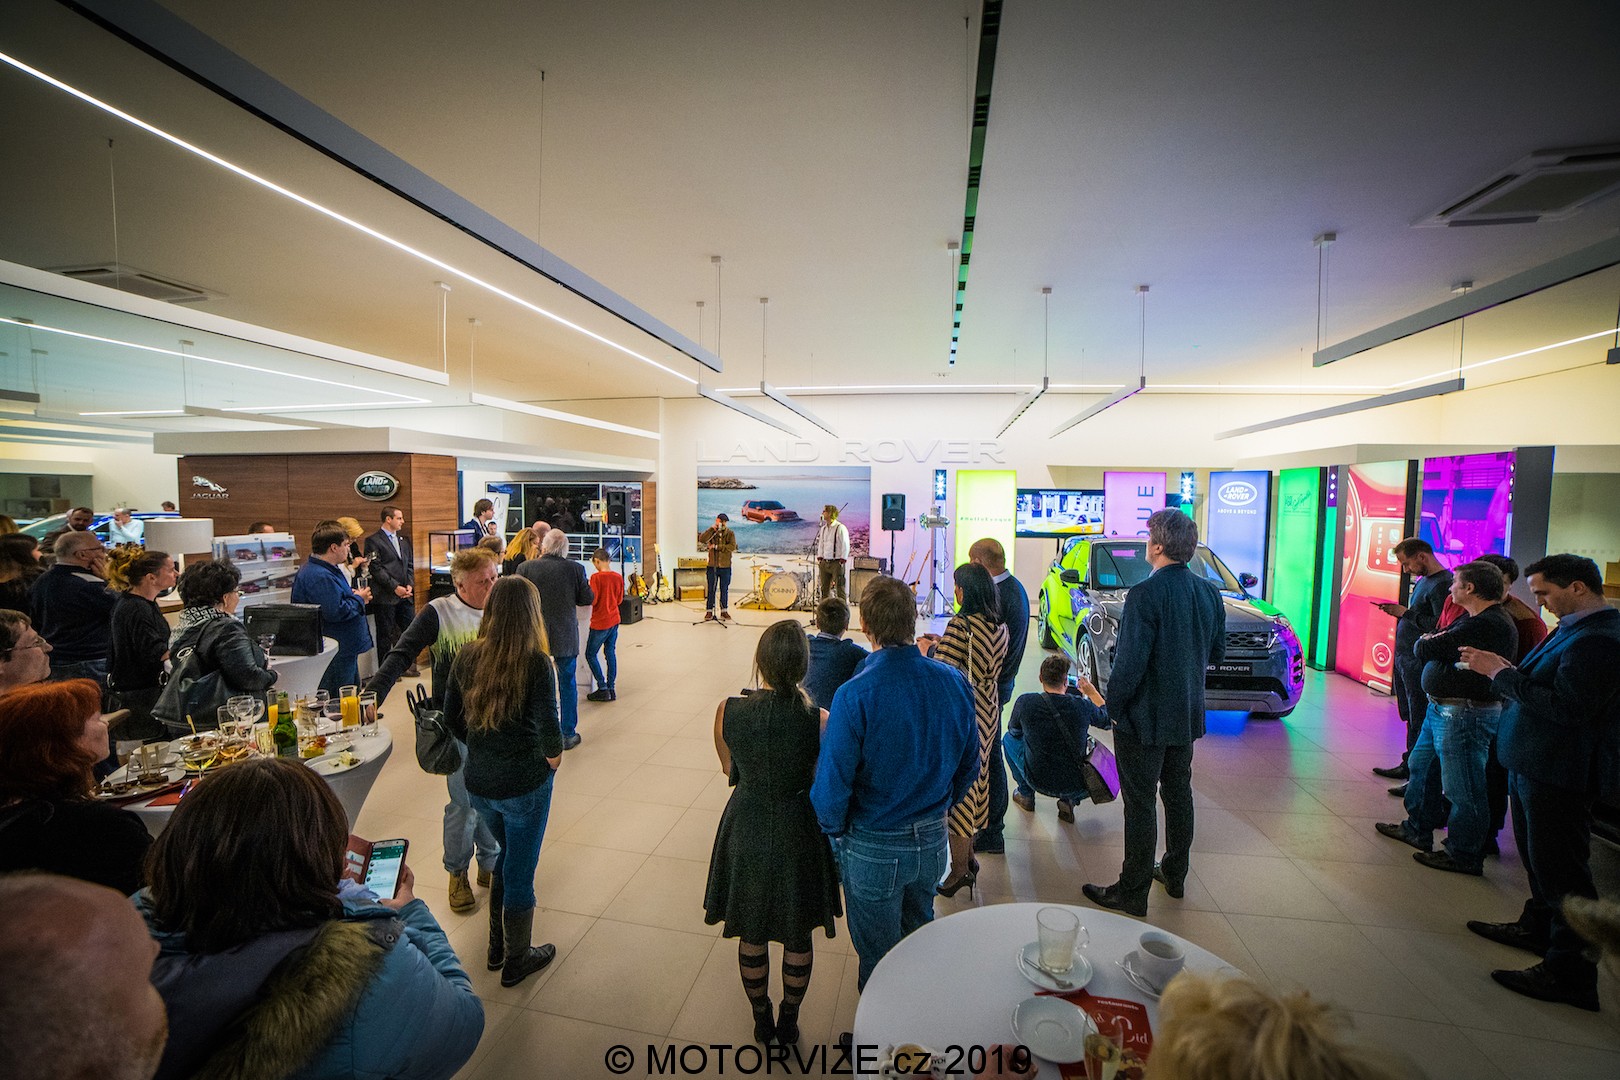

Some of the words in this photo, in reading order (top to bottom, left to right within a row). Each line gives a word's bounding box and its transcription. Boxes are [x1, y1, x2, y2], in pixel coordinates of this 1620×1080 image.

[697, 439, 820, 463] LAND
[839, 439, 1006, 464] ROVER
[363, 477, 383, 486] LAND
[365, 485, 390, 493] ROVER
[1136, 486, 1154, 536] UE
